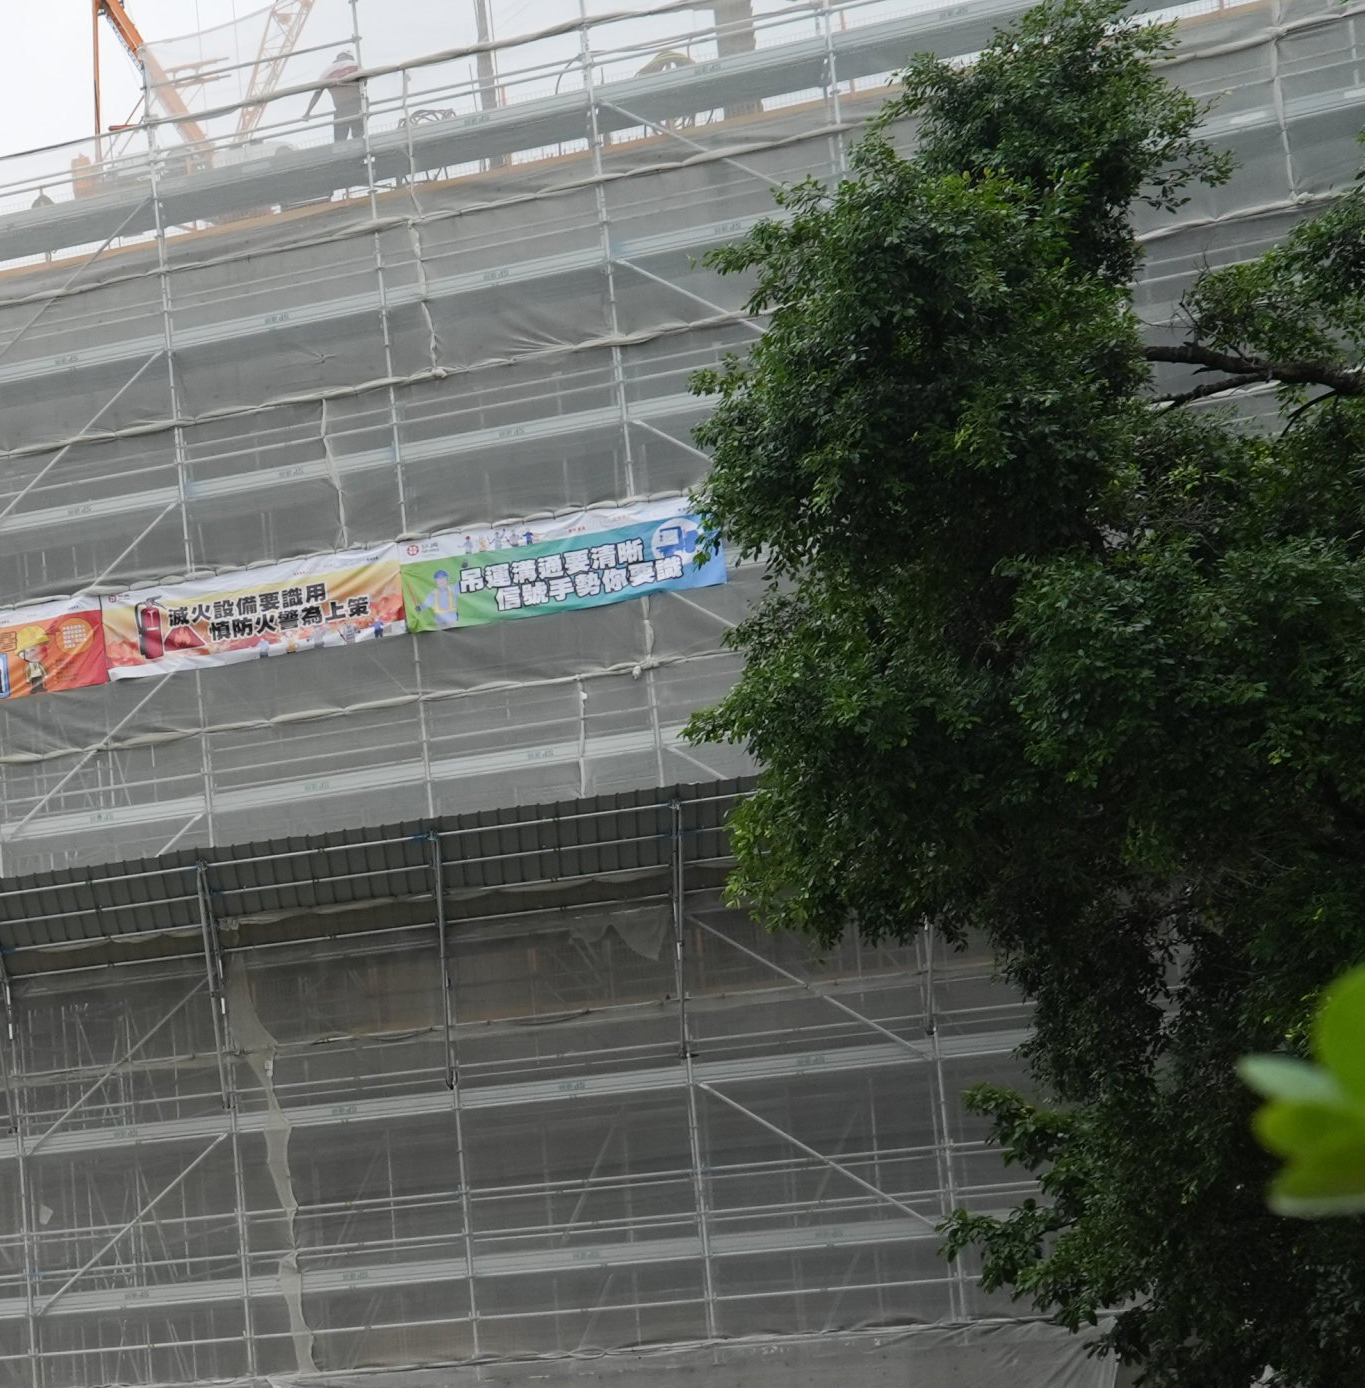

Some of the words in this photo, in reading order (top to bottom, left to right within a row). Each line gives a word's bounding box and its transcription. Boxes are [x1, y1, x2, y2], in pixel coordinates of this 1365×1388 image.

[459, 538, 645, 594] 吊運溝通要清晰
[495, 555, 684, 611] 信號手勢你要識
[168, 583, 327, 627] 滅火設備要識用
[209, 596, 370, 641] 慎防火警為上策
